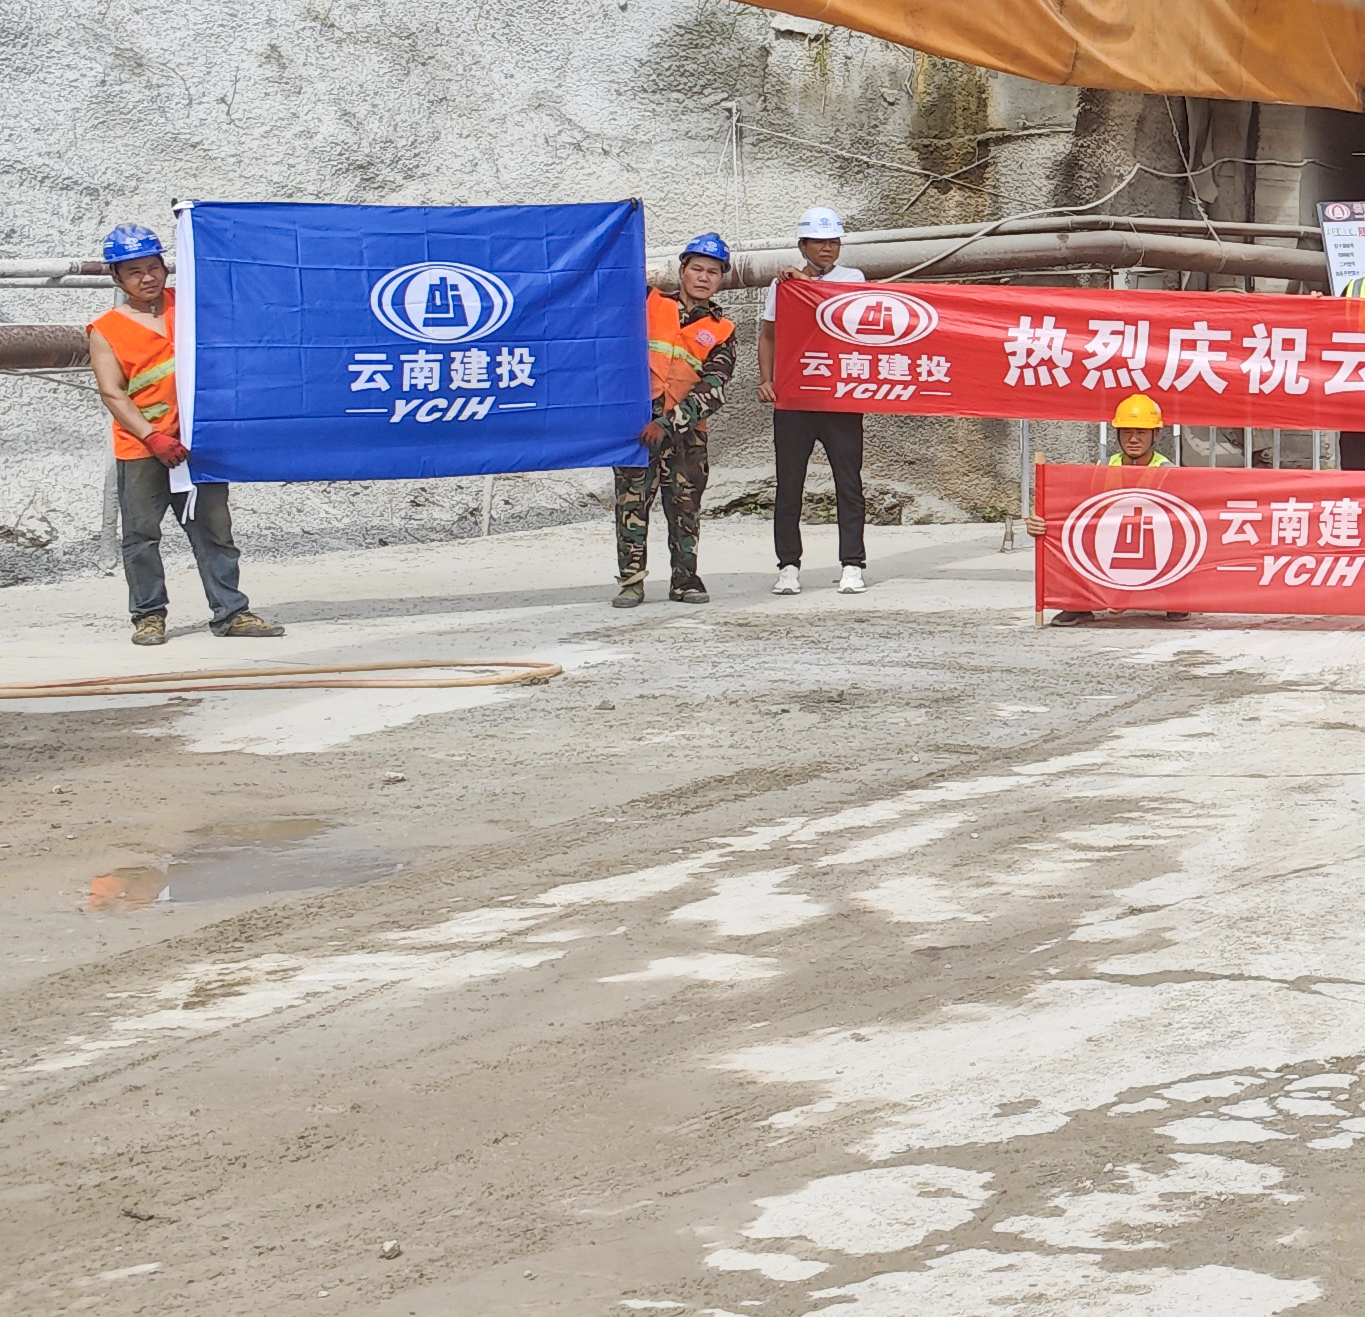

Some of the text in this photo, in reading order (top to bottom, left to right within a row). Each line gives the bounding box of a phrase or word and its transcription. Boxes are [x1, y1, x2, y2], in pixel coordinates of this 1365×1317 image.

[347, 346, 537, 392] 云南建投
[800, 351, 952, 385] 云南建投
[834, 382, 917, 401] YCIH
[389, 396, 495, 425] YCIH
[1258, 556, 1365, 588] YCIH
